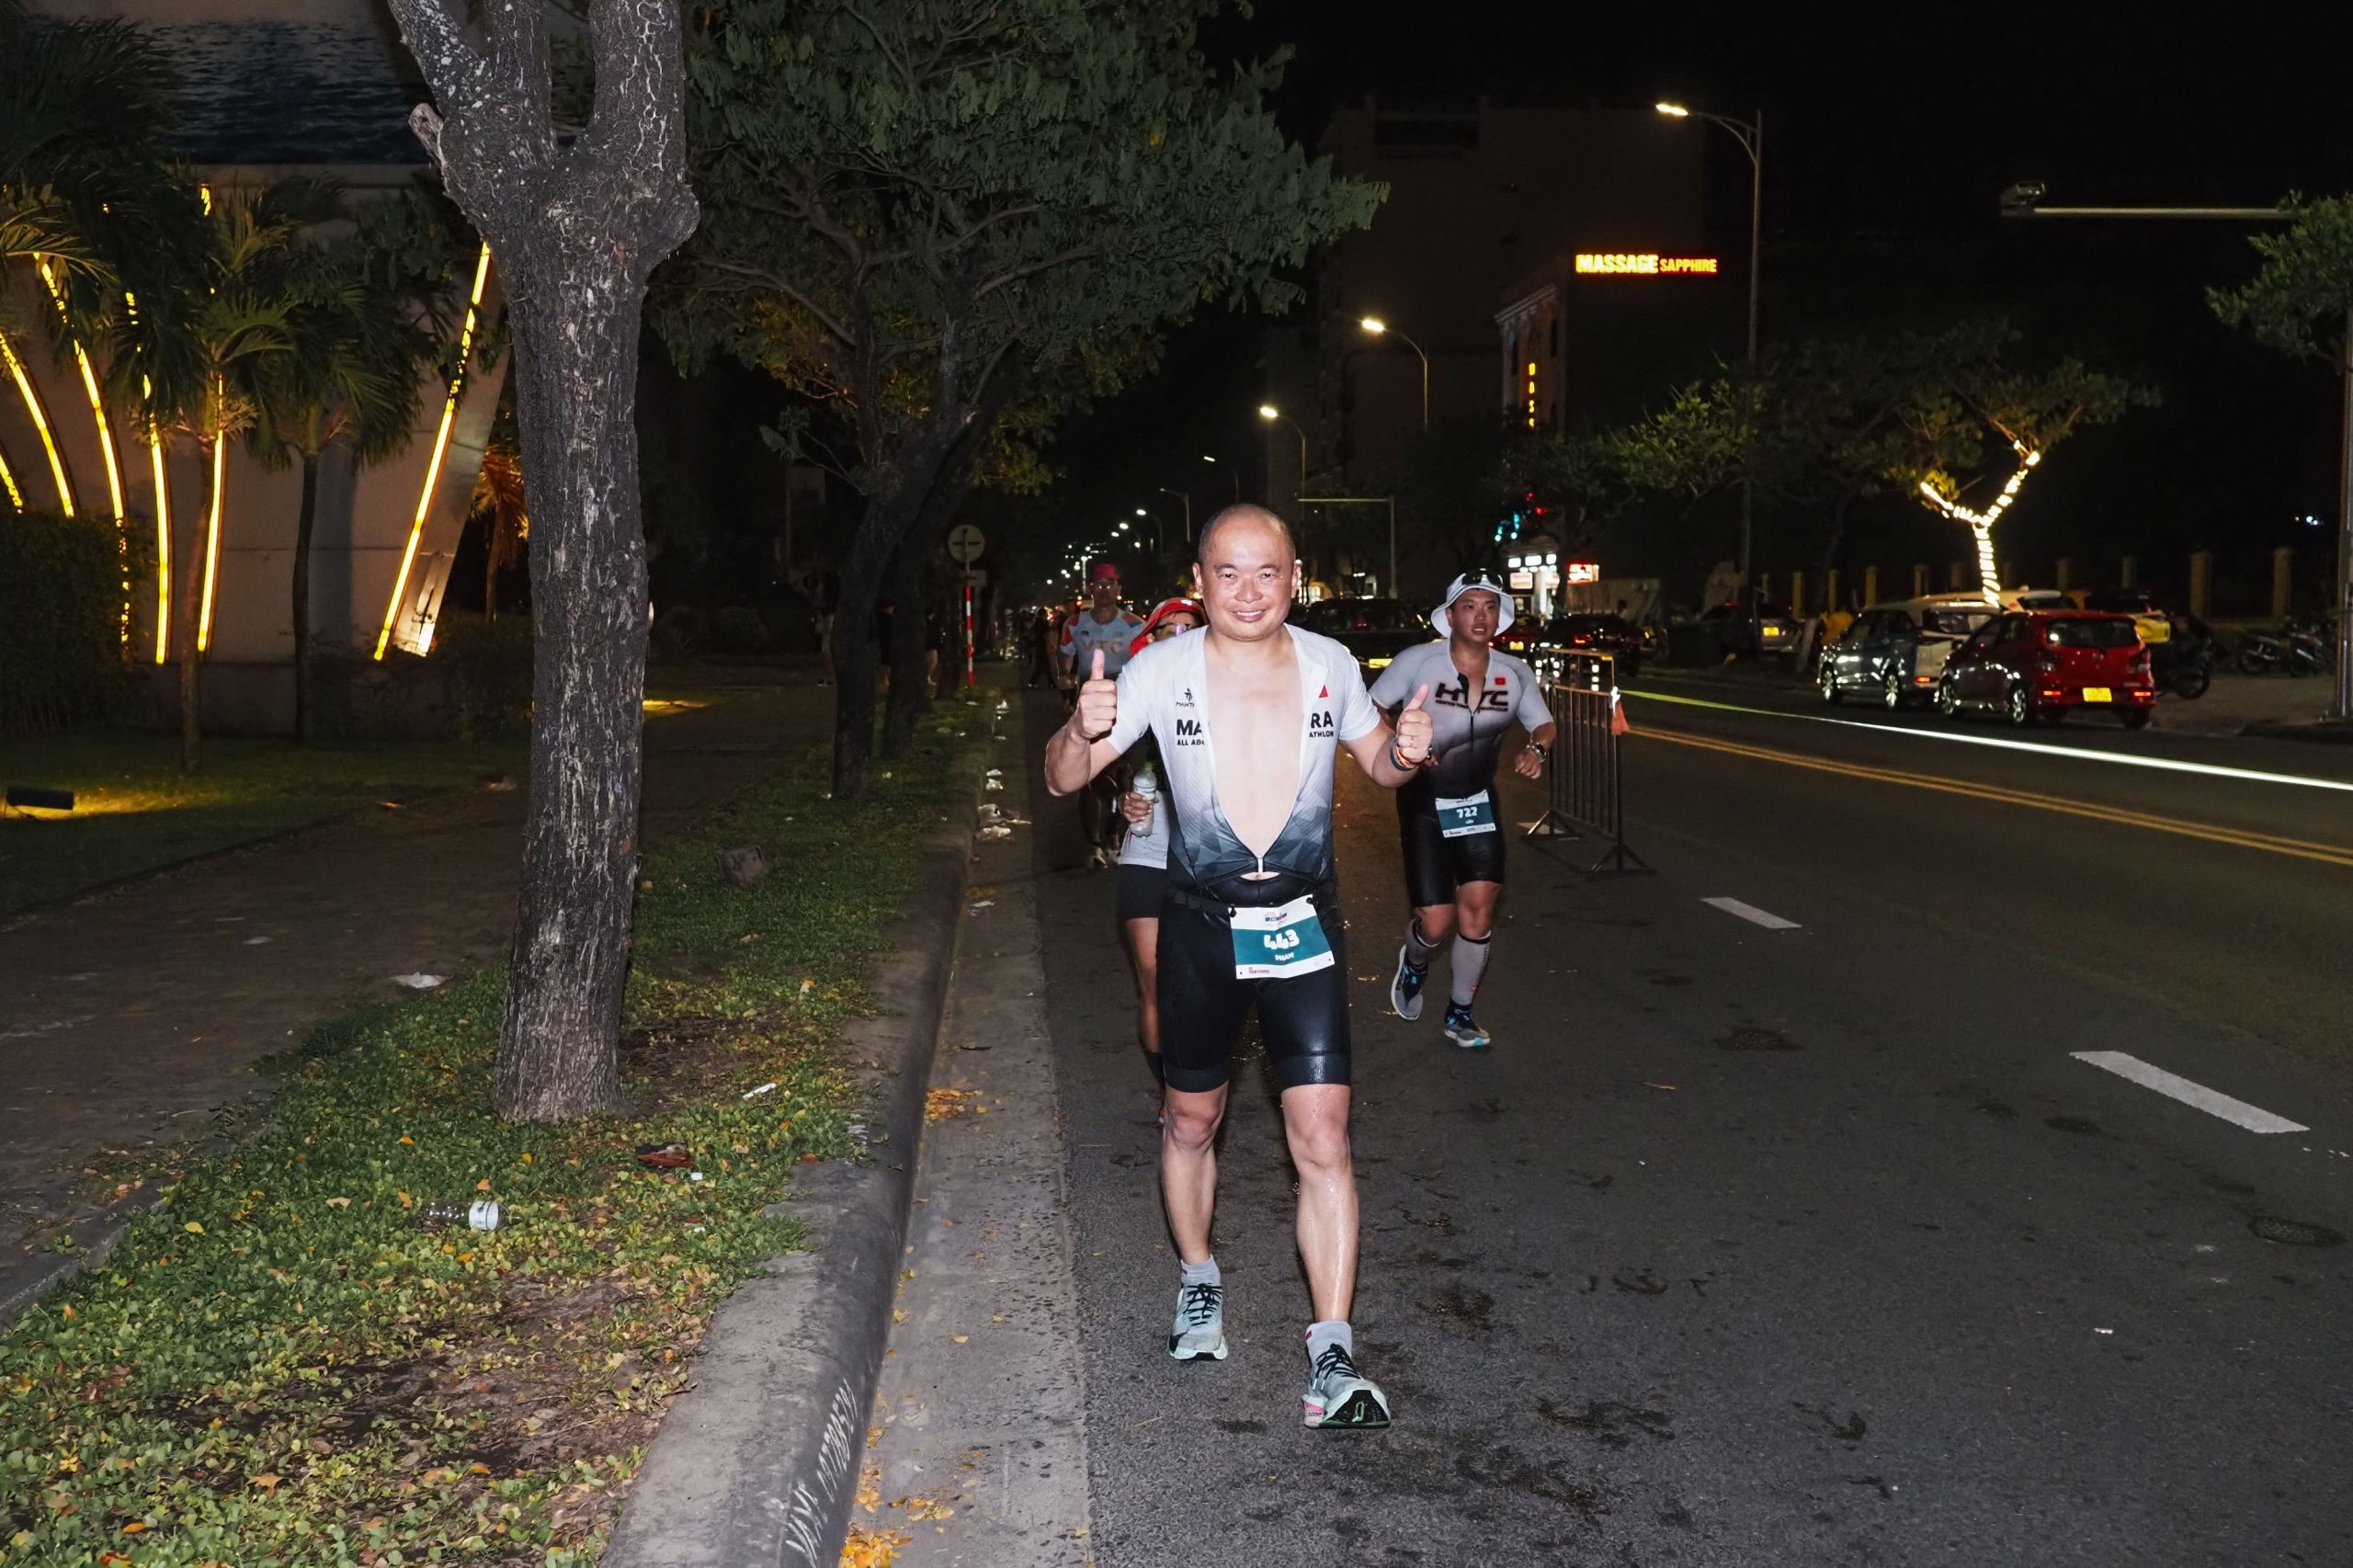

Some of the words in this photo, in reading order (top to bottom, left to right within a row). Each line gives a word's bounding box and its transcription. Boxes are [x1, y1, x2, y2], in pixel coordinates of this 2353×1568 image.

[1575, 254, 1658, 273] MASSAGE
[1660, 258, 1717, 273] SAPPHIRE
[1456, 806, 1478, 819] 722
[1264, 929, 1300, 950] 443
